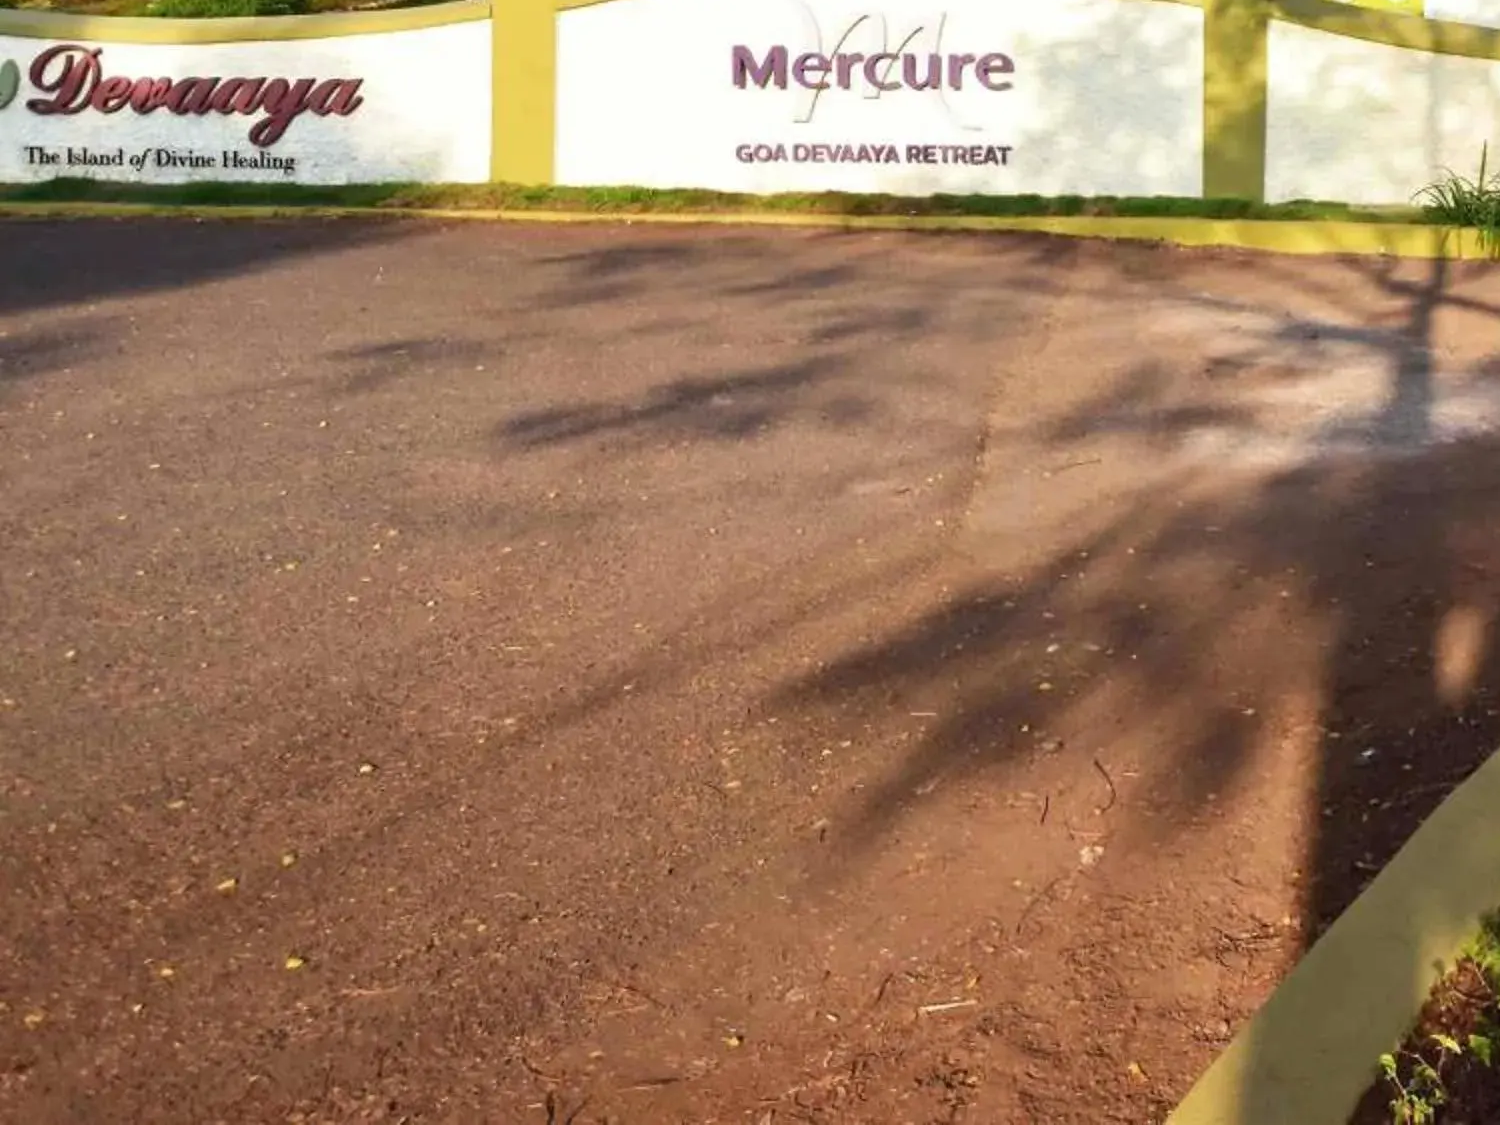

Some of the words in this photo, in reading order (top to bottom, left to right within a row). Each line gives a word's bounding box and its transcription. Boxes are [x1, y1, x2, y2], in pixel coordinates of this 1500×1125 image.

[731, 44, 1016, 92] Mercure
[26, 43, 364, 148] Devaaya
[24, 146, 61, 166] The
[67, 146, 124, 167] Island
[129, 147, 153, 173] of
[155, 149, 217, 170] Divine
[222, 150, 296, 174] Healing
[735, 143, 789, 164] GOA
[792, 143, 900, 165] DEVAAYA
[905, 144, 1013, 166] RETREAT
